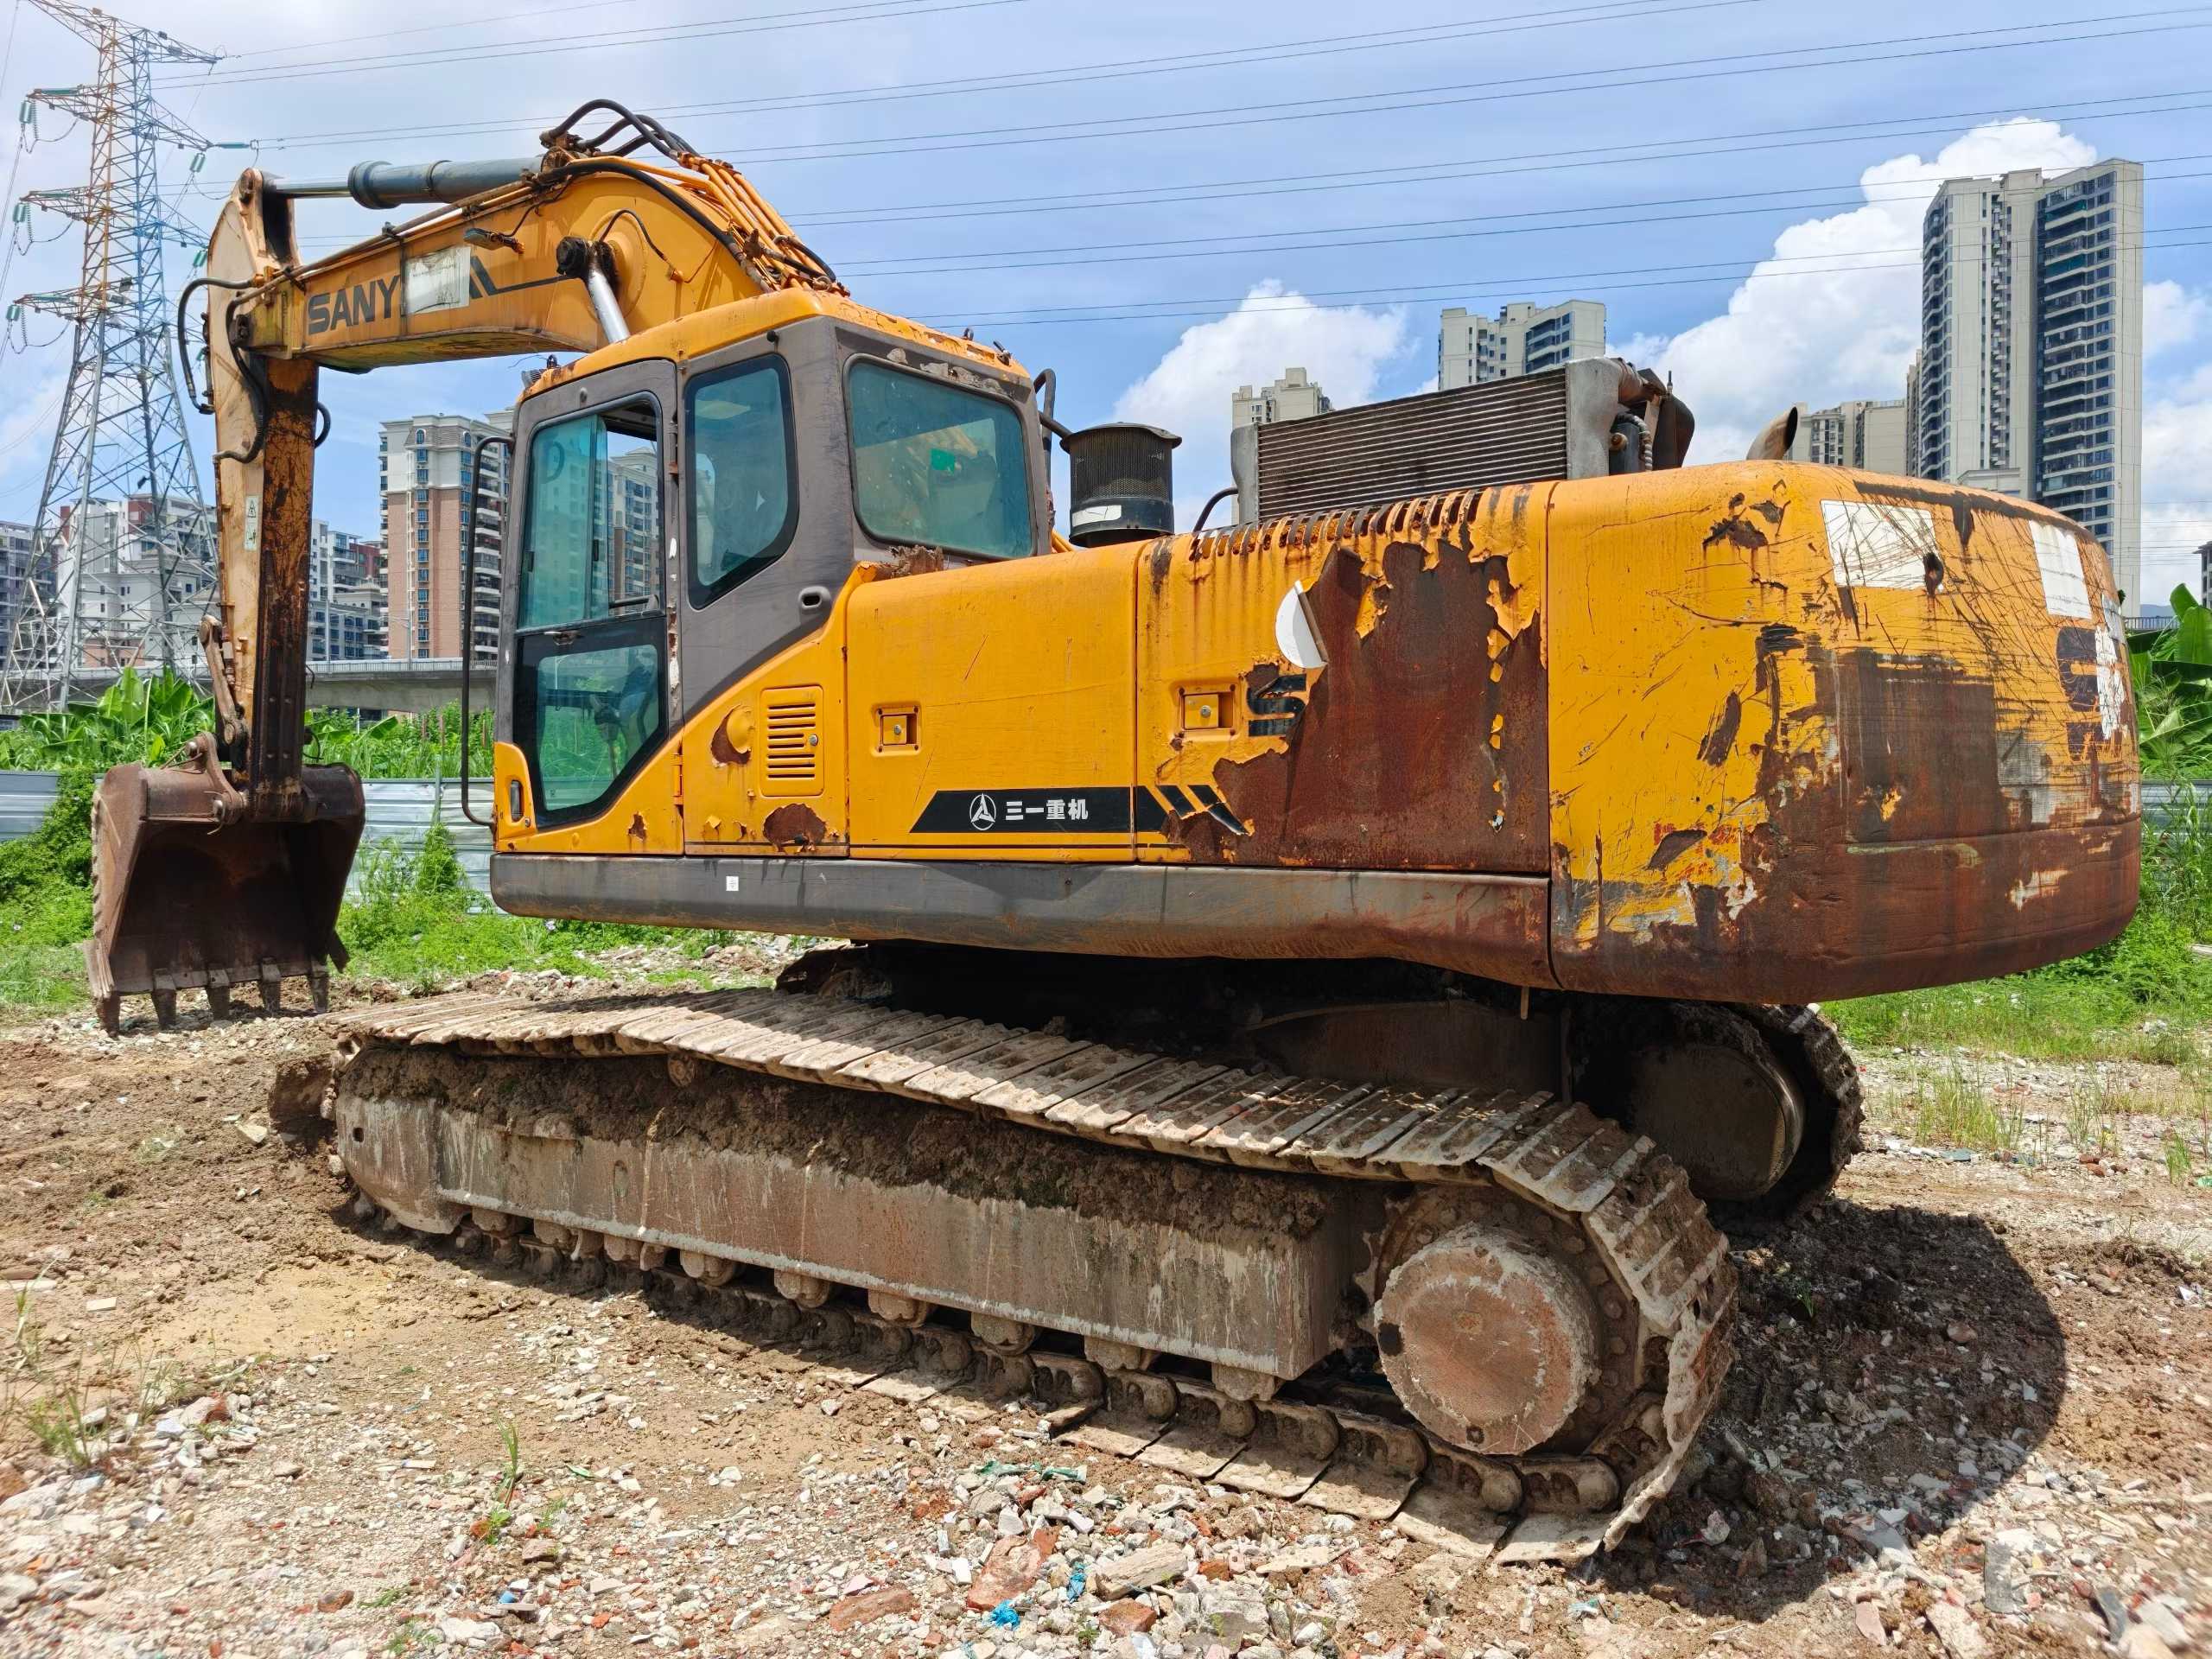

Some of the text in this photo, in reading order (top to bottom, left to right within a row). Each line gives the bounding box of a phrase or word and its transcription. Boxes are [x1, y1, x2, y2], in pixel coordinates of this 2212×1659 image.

[308, 275, 401, 336] SANY
[1005, 798, 1089, 821] 三一重机
